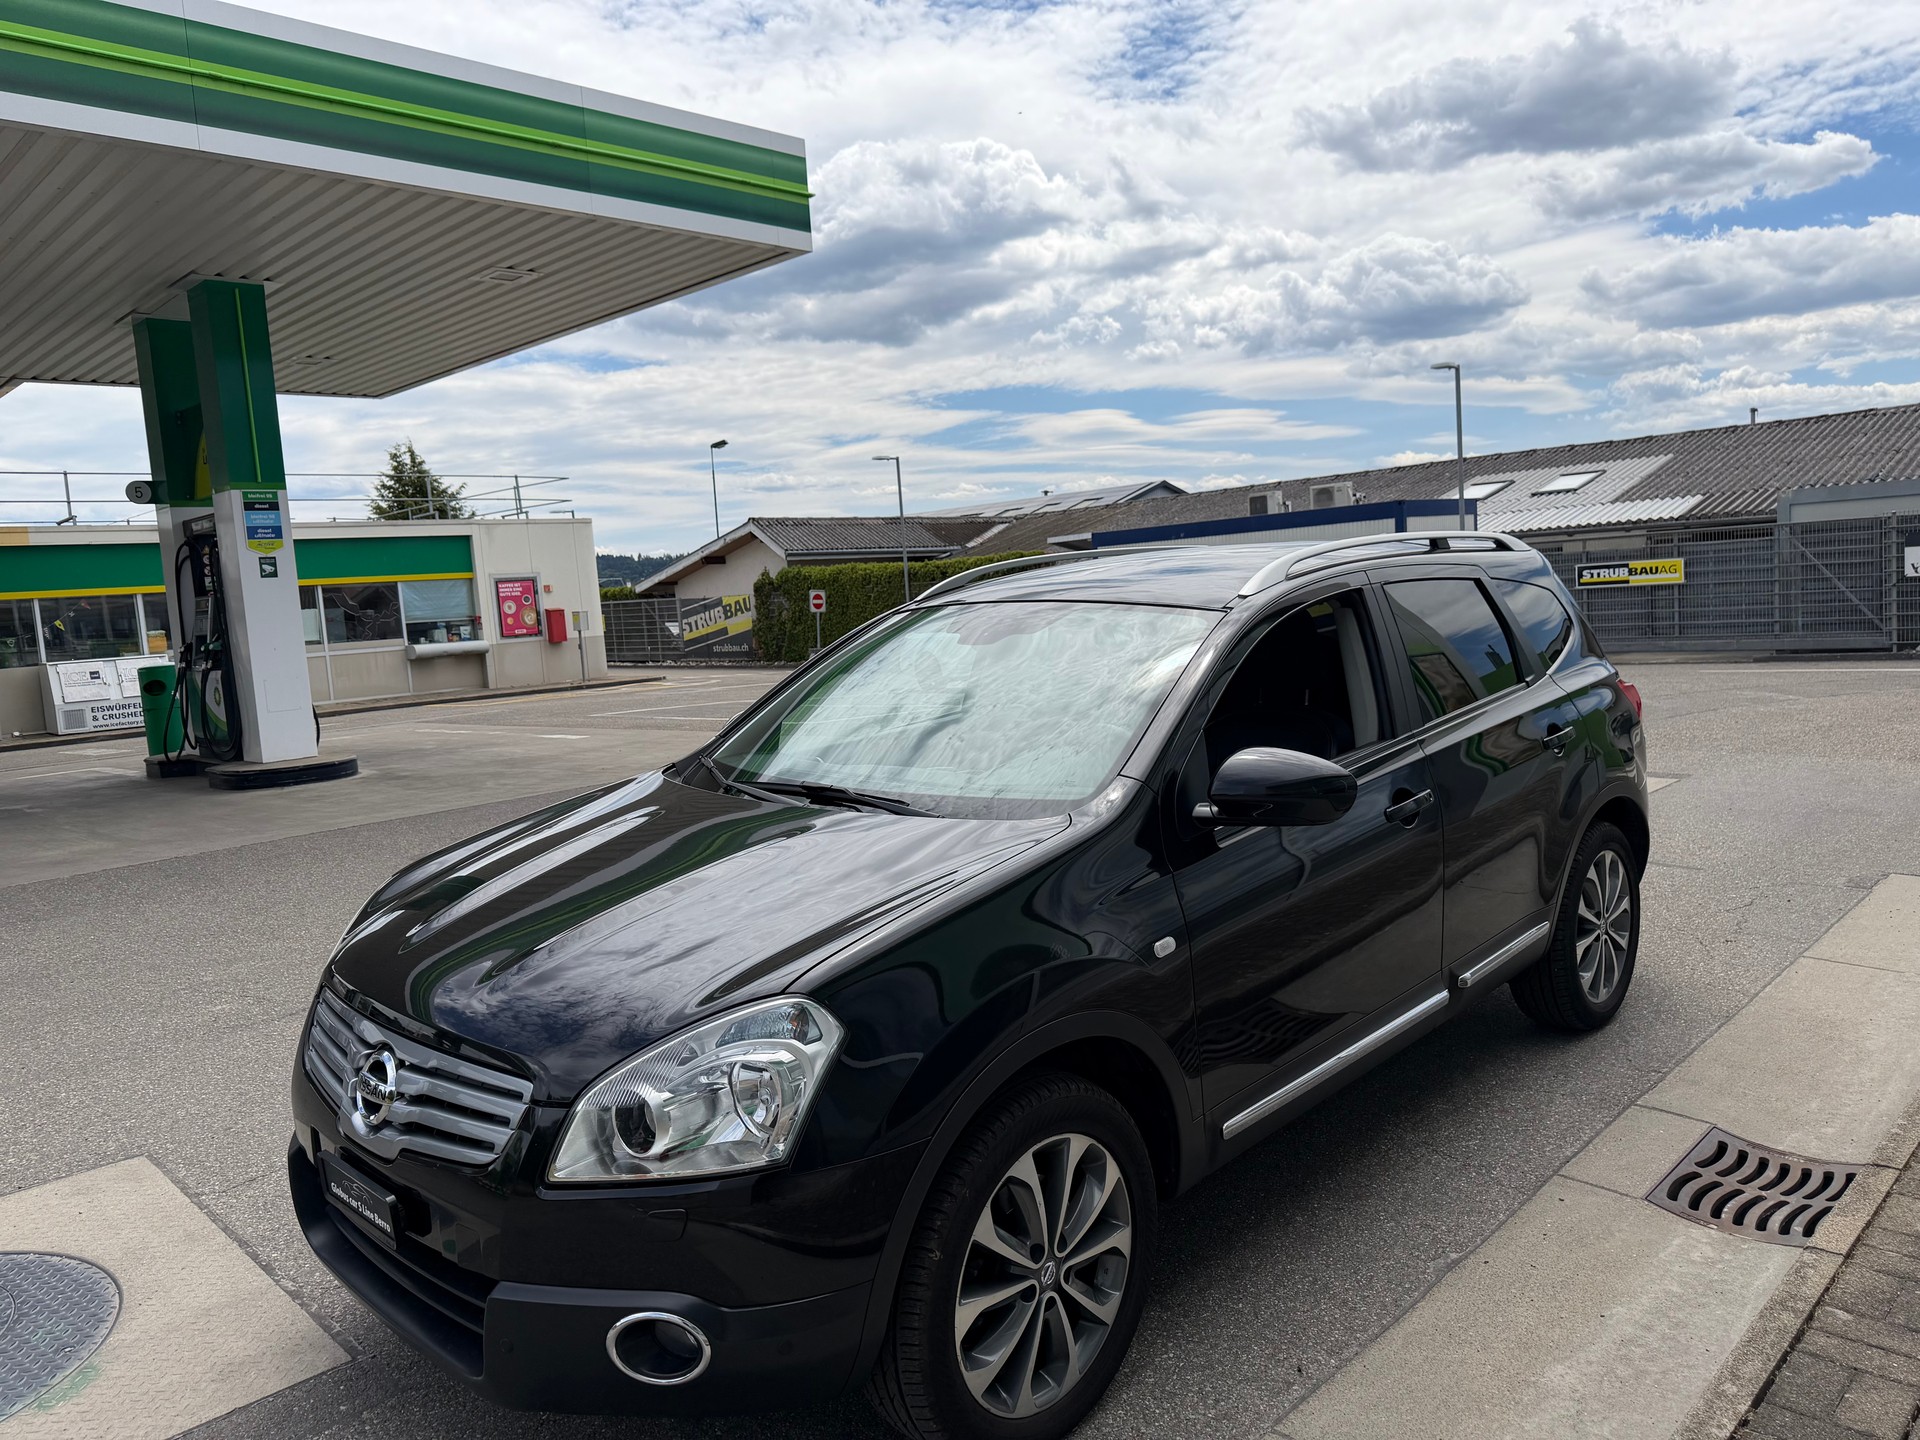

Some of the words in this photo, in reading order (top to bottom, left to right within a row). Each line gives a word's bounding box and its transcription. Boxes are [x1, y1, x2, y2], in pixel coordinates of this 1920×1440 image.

[134, 486, 143, 498] 5
[682, 596, 751, 634] STRUBBAU
[713, 643, 749, 653] strubbau.ch
[122, 667, 138, 678] IC
[92, 714, 99, 722] &
[93, 720, 145, 729] www.icefactory.c
[331, 1182, 349, 1203] Globus
[358, 1201, 362, 1212] S
[362, 1204, 375, 1222] Line
[374, 1213, 391, 1233] Berro
